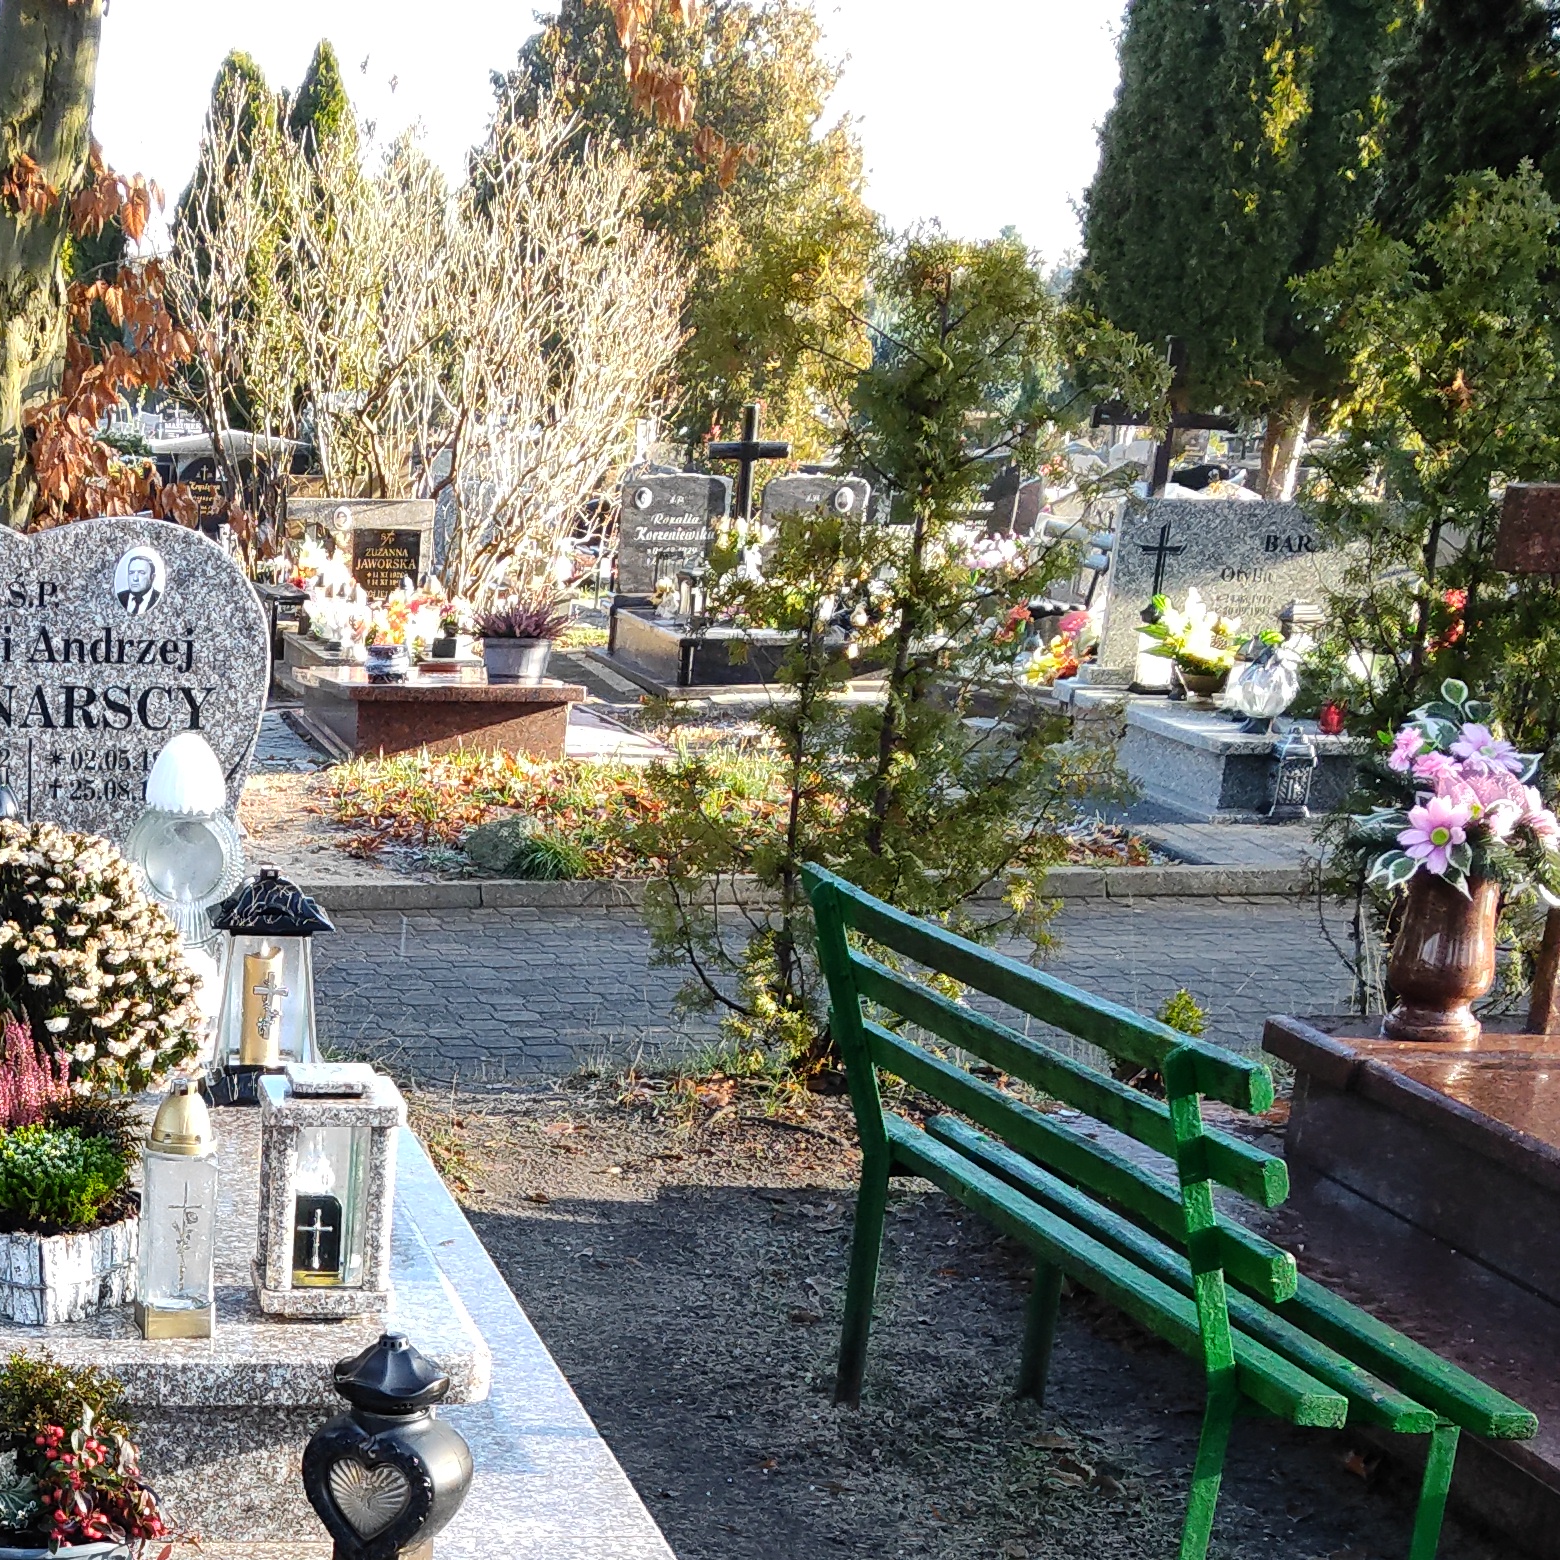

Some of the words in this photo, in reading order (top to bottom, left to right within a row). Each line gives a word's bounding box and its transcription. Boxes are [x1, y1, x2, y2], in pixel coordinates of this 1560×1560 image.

[355, 558, 417, 570] JAWORSKA
[1, 625, 13, 662] i
[27, 624, 195, 672] Andrzej
[70, 749, 161, 772] 02.05.1
[69, 779, 148, 801] 25.08.1
